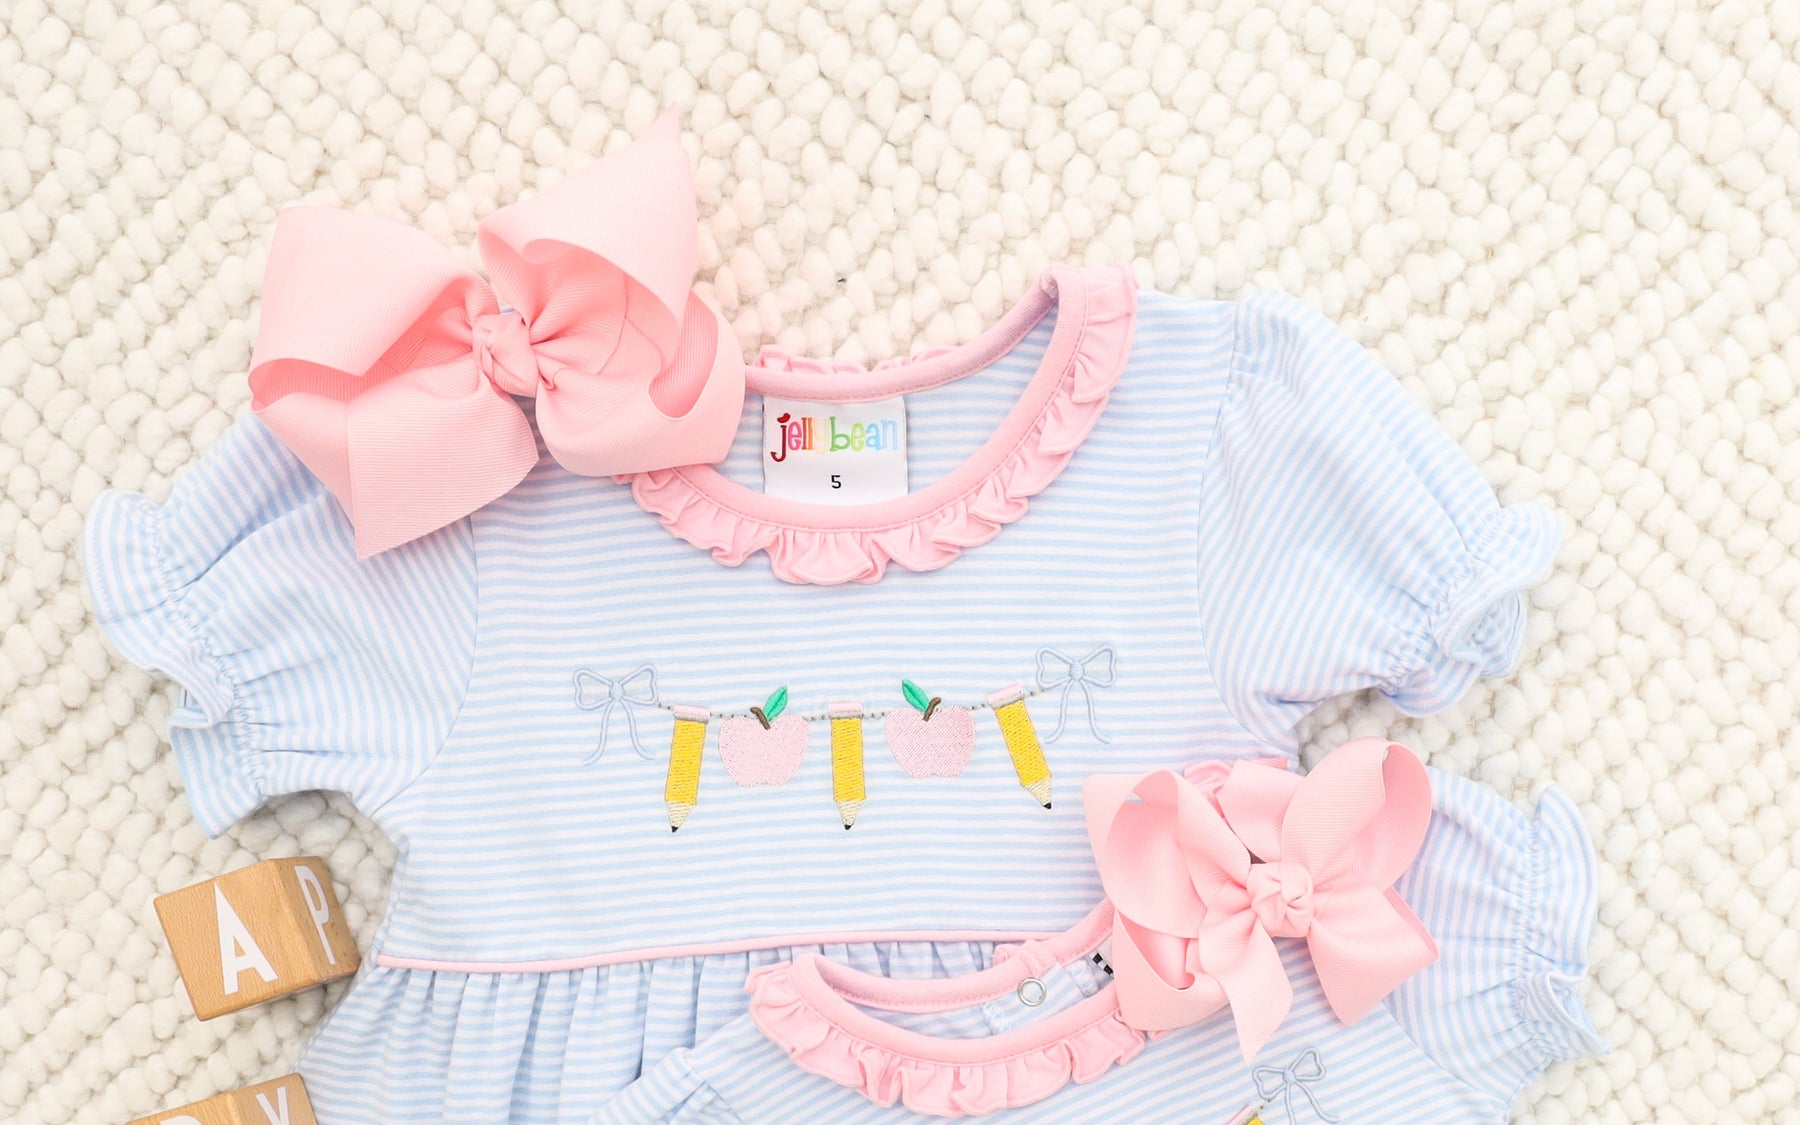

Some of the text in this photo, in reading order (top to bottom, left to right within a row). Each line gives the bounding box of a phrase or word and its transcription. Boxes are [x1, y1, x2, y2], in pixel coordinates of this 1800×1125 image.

[770, 412, 898, 463] jellybean
[831, 474, 842, 489] 5
[214, 882, 279, 996] A
[294, 865, 336, 965] P
